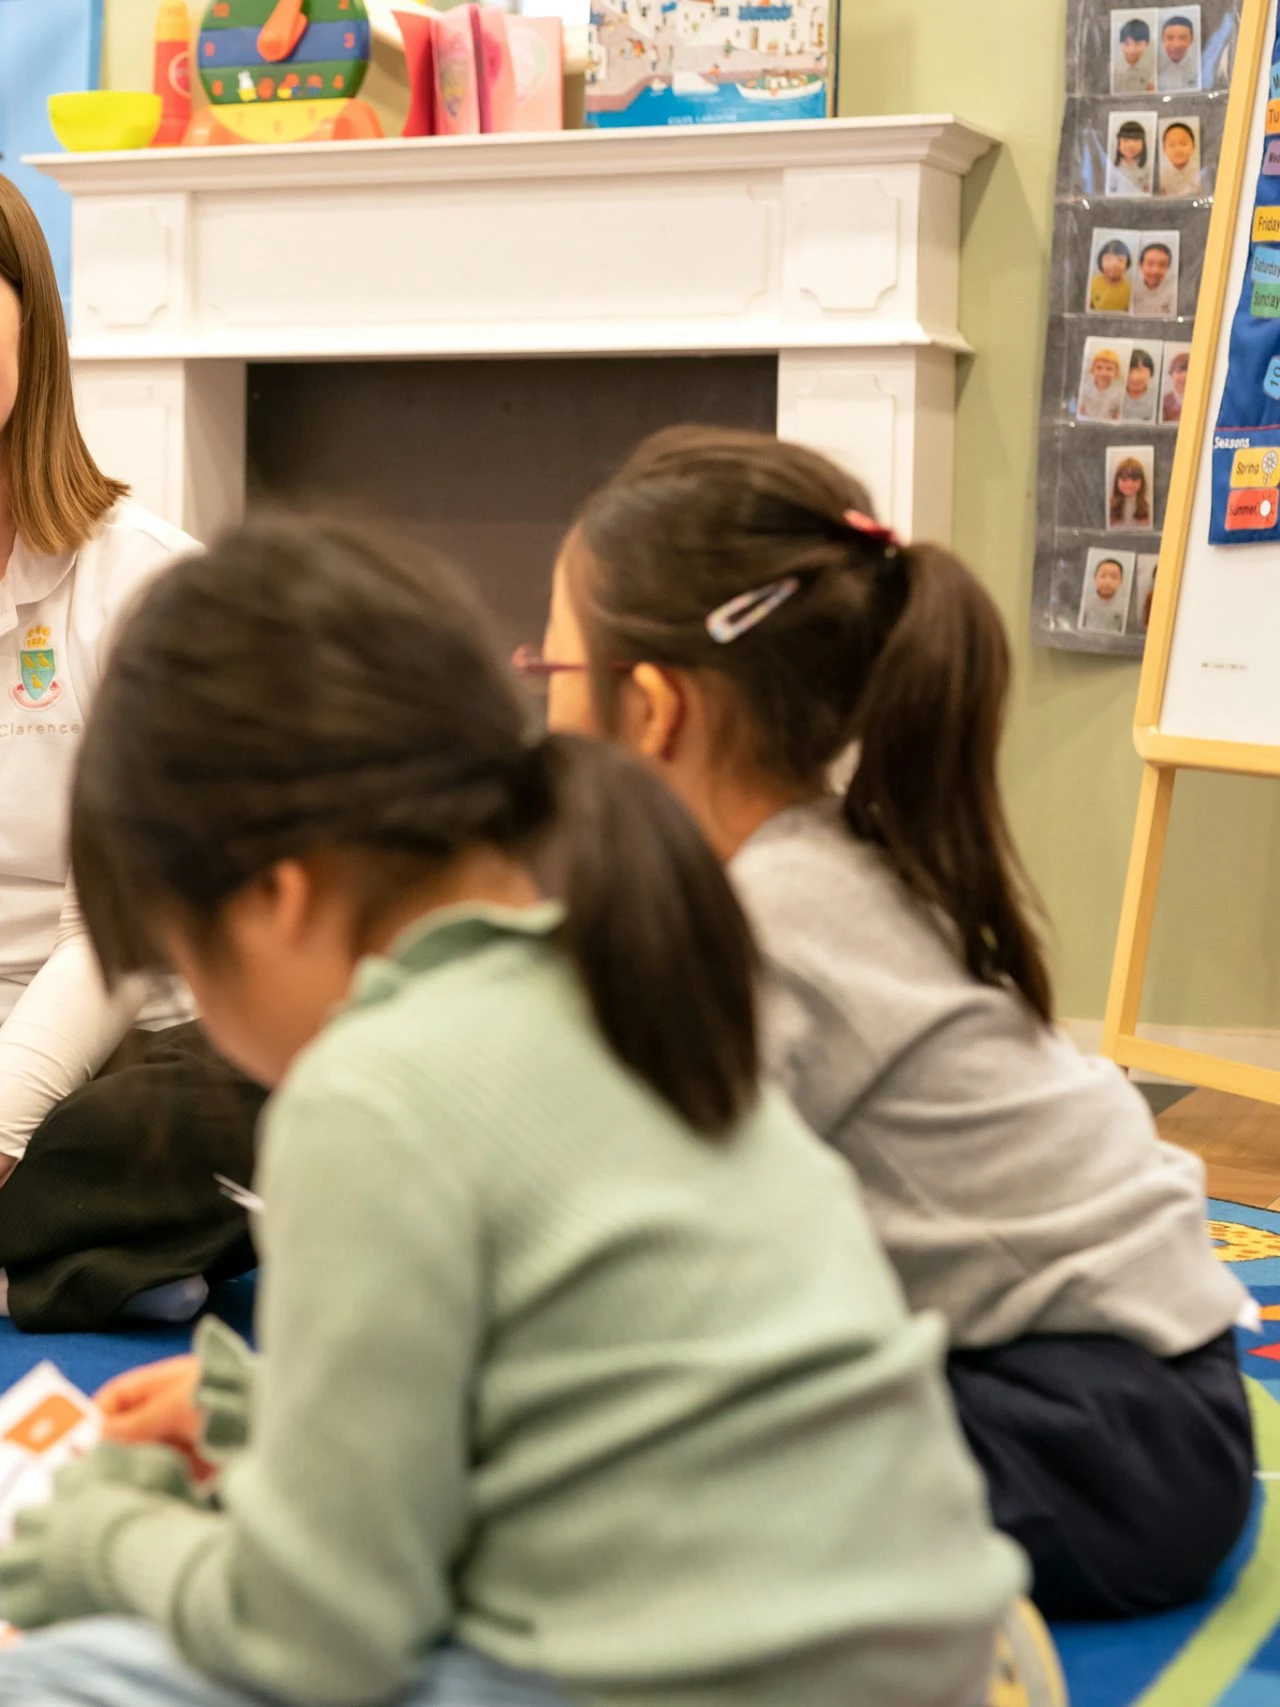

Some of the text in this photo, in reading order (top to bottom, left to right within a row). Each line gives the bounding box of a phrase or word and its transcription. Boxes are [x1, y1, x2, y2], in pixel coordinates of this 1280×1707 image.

[1258, 216, 1280, 232] Friday
[1254, 255, 1280, 278] Saturday
[1254, 291, 1280, 309] Sunday
[1214, 436, 1250, 449] Seasons
[1236, 461, 1260, 475] Spring
